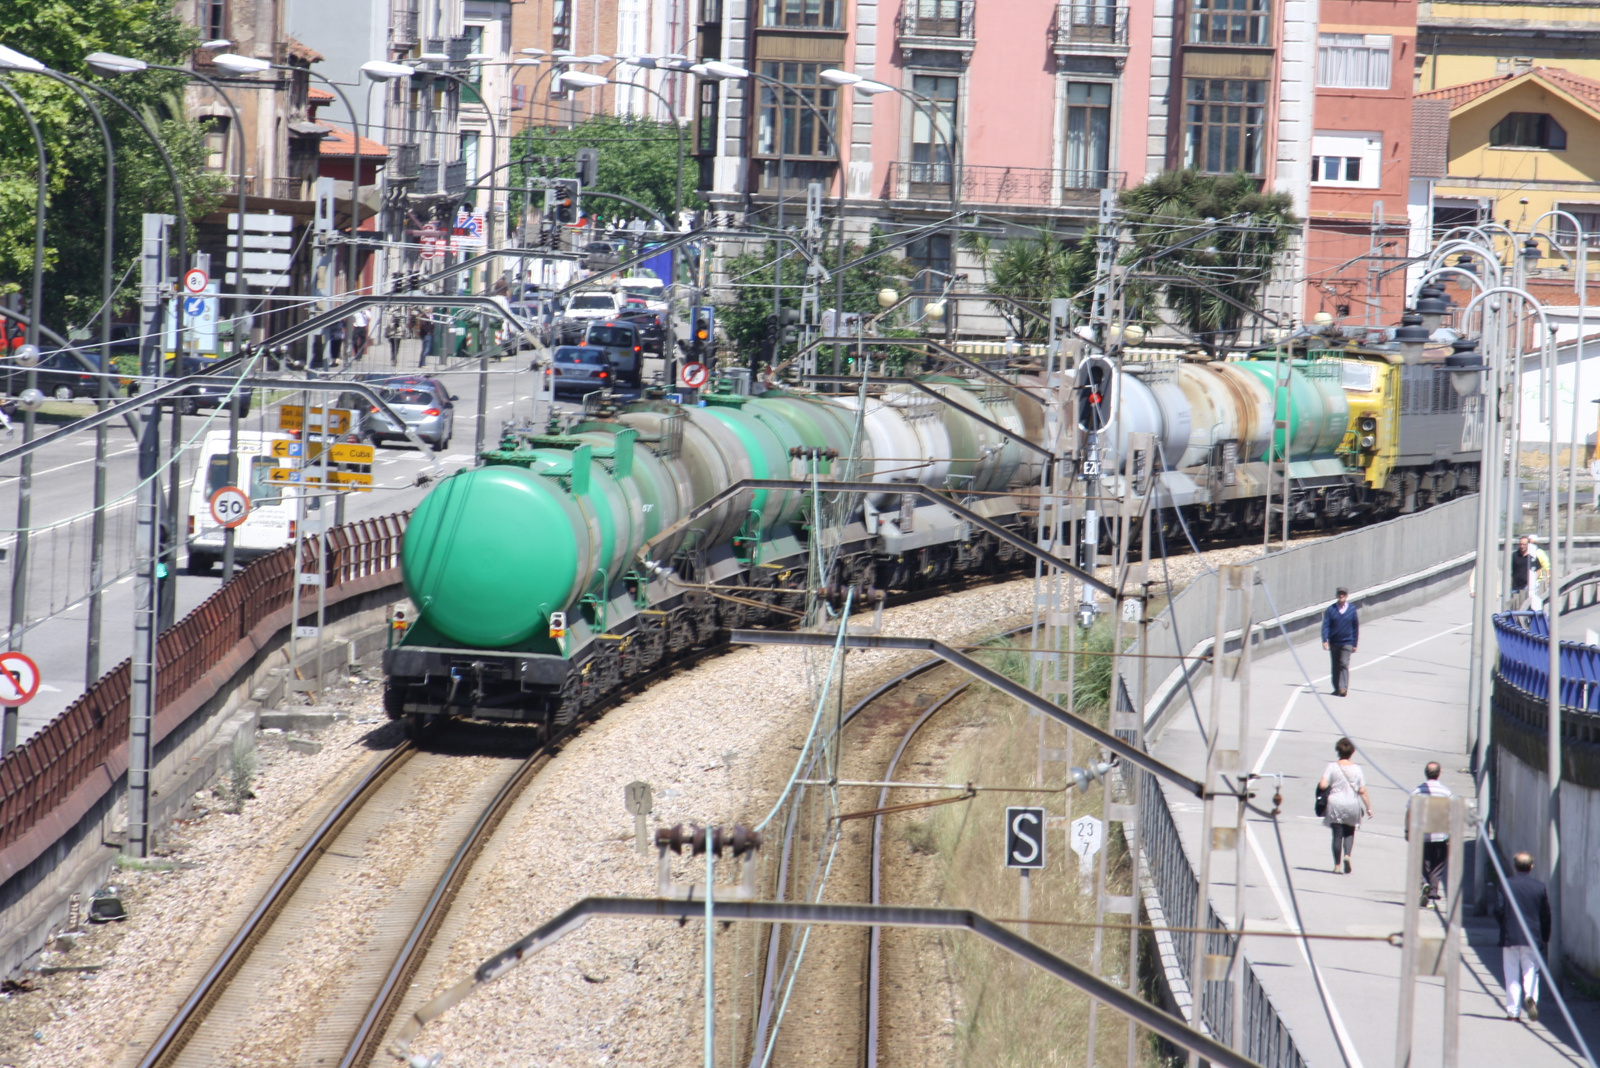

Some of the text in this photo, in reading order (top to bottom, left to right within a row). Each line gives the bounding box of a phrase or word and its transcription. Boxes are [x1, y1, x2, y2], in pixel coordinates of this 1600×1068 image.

[349, 449, 371, 458] Cuba
[218, 500, 243, 514] 50
[1124, 604, 1136, 614] 23
[632, 786, 646, 801] 17
[635, 801, 642, 816] 2
[1077, 822, 1094, 837] 23
[1012, 812, 1040, 864] S
[1082, 842, 1090, 856] 7
